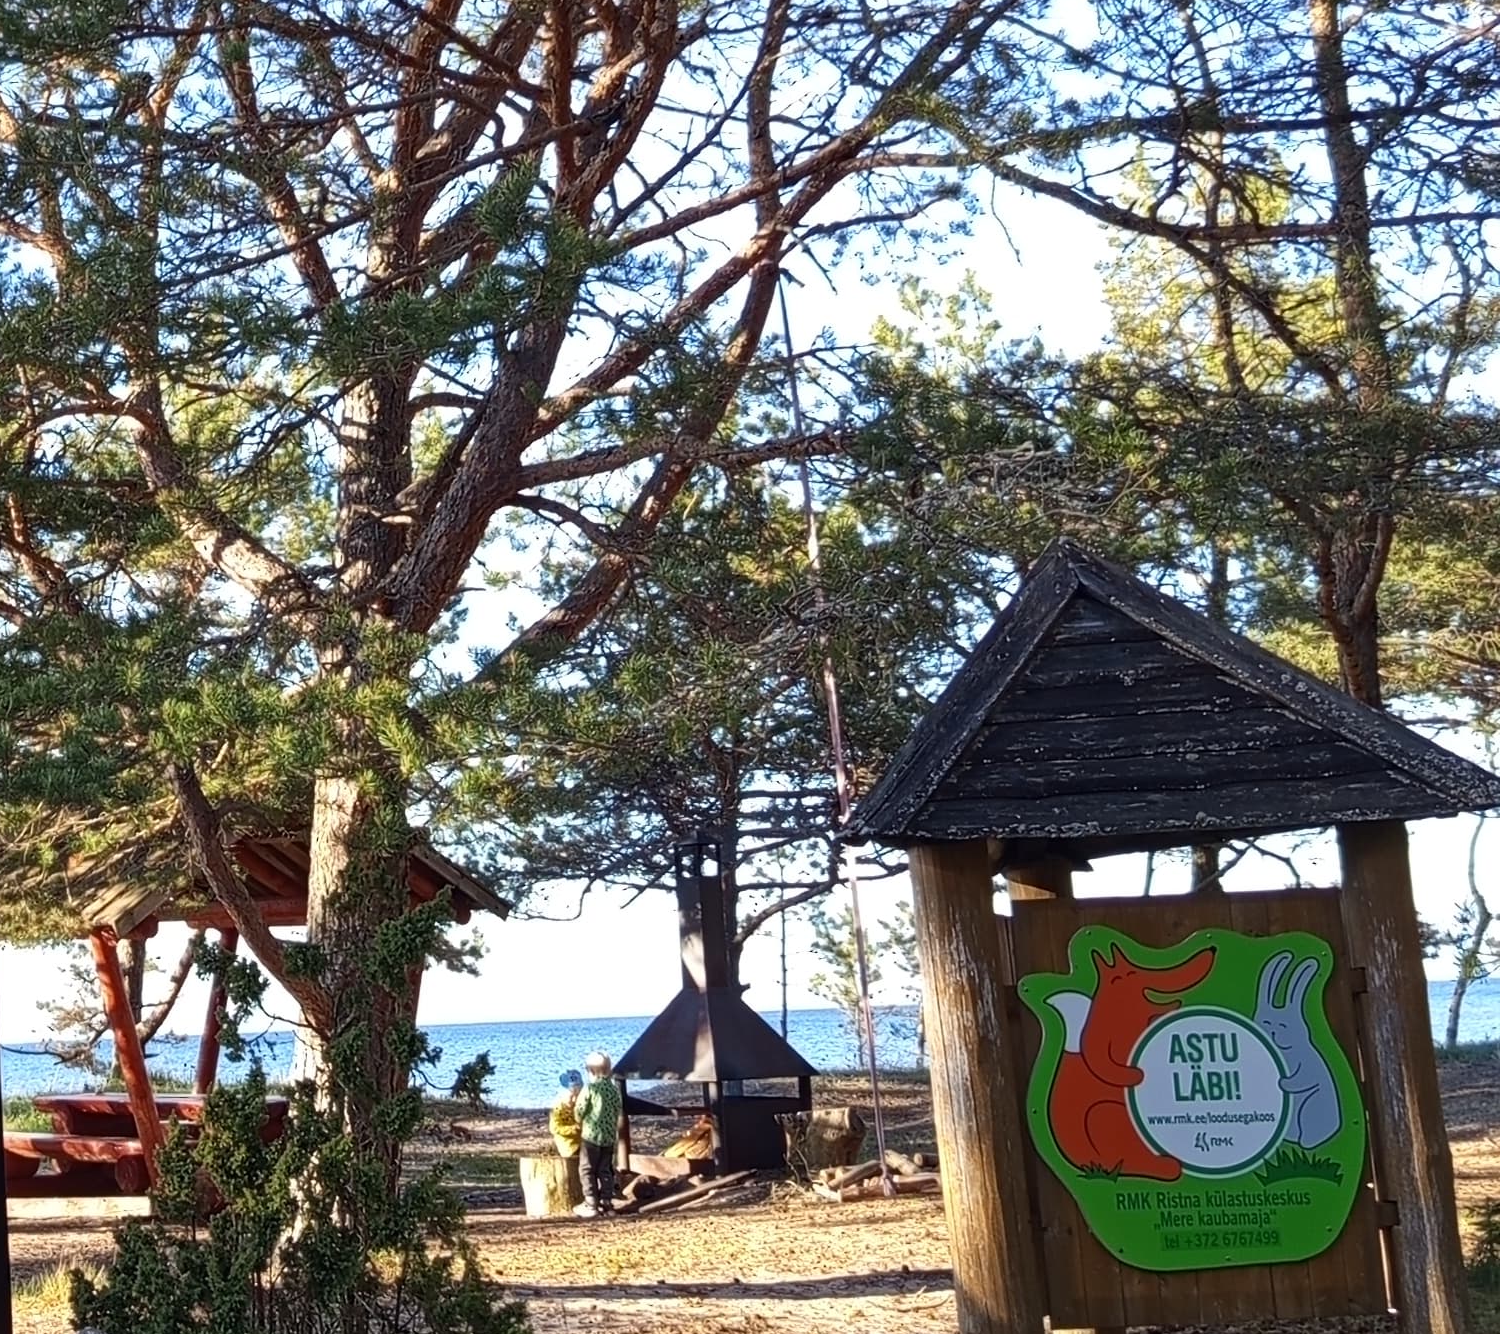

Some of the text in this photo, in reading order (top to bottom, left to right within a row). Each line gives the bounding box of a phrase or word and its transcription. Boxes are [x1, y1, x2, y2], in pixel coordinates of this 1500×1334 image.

[1169, 1033, 1239, 1064] ASTU
[1173, 1065, 1242, 1102] LÄBI!
[1147, 1111, 1275, 1126] www.rmk.ee/loodusegakoos
[1116, 1189, 1311, 1210] RMK Ristna külastuskeskus
[1165, 1230, 1279, 1249] tel +372 6767499
